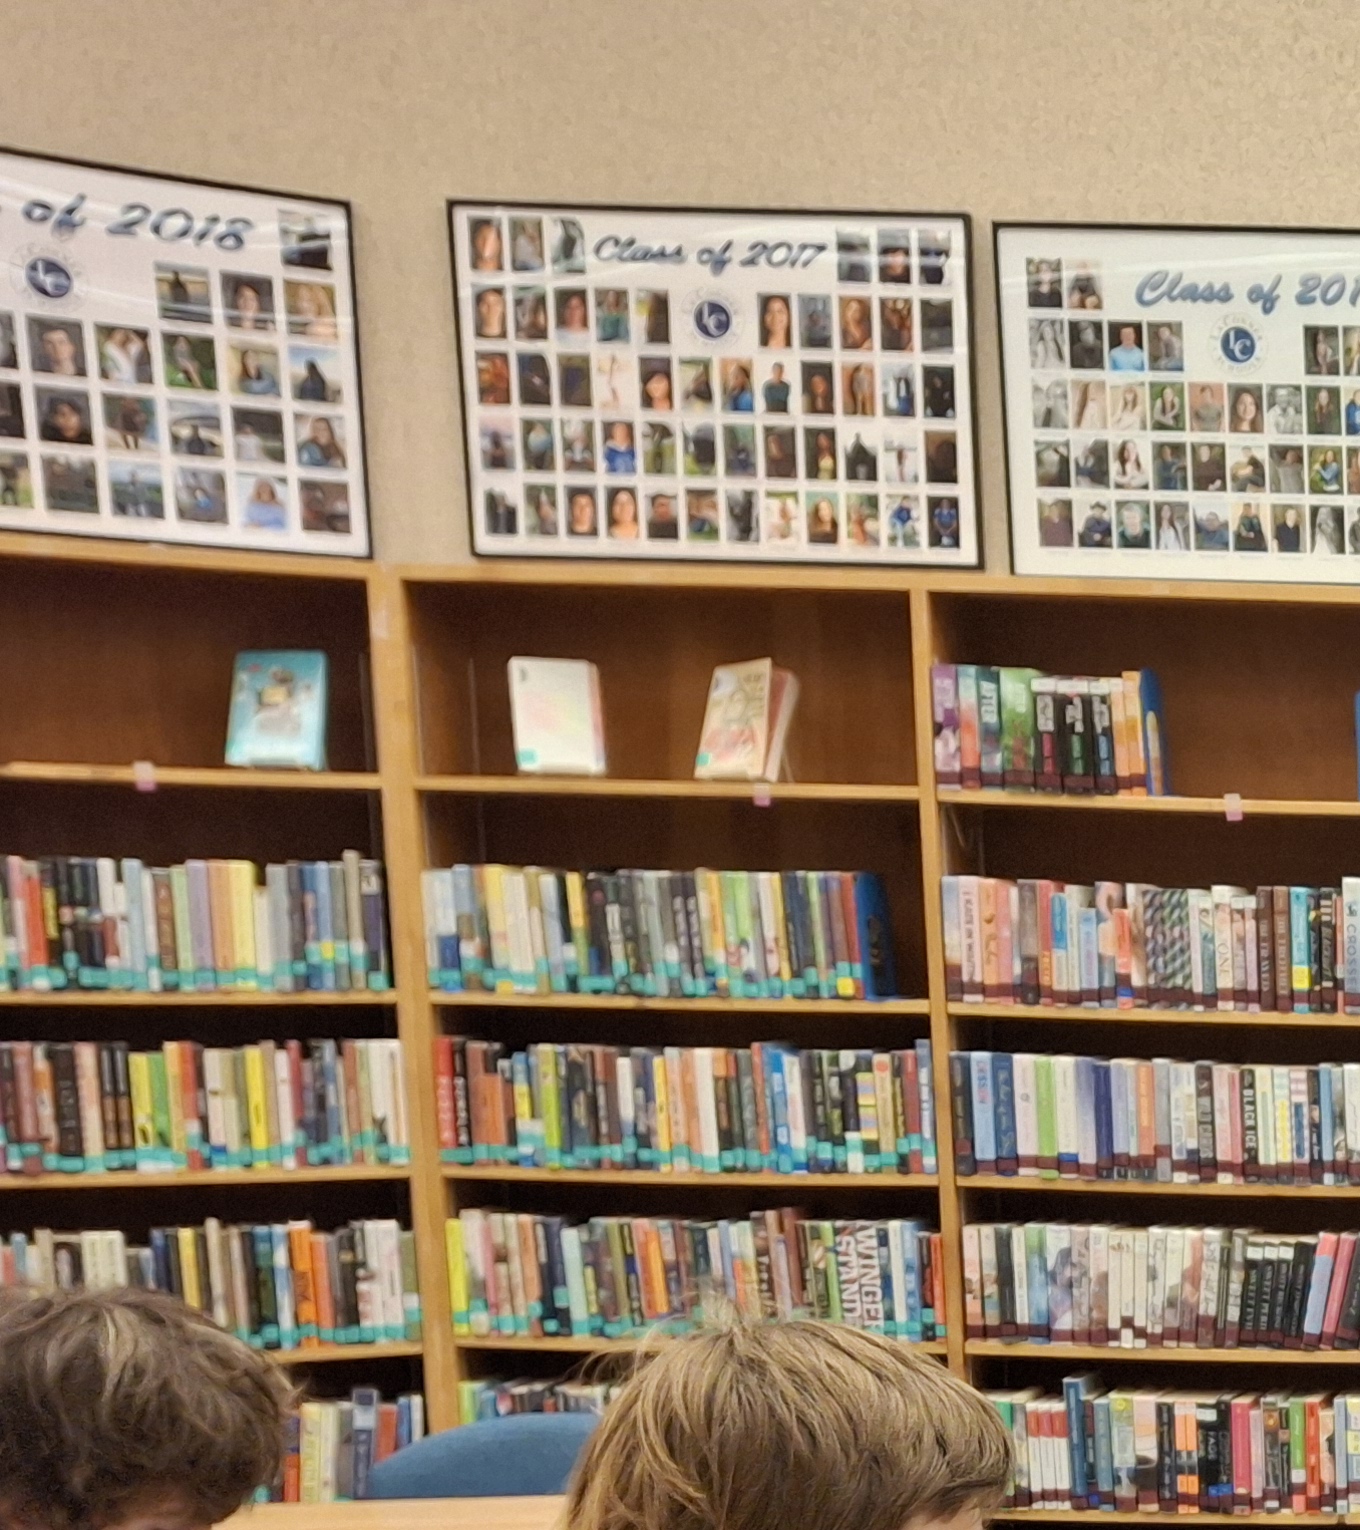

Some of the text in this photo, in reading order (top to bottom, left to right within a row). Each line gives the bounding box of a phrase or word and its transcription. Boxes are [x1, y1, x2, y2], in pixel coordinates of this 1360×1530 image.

[22, 193, 254, 253] of 2018
[594, 234, 827, 276] Class of 2017
[1135, 270, 1234, 307] Class
[1248, 275, 1281, 315] of
[1346, 924, 1358, 993] CROSSE
[1242, 1088, 1256, 1148] BLACK ICE
